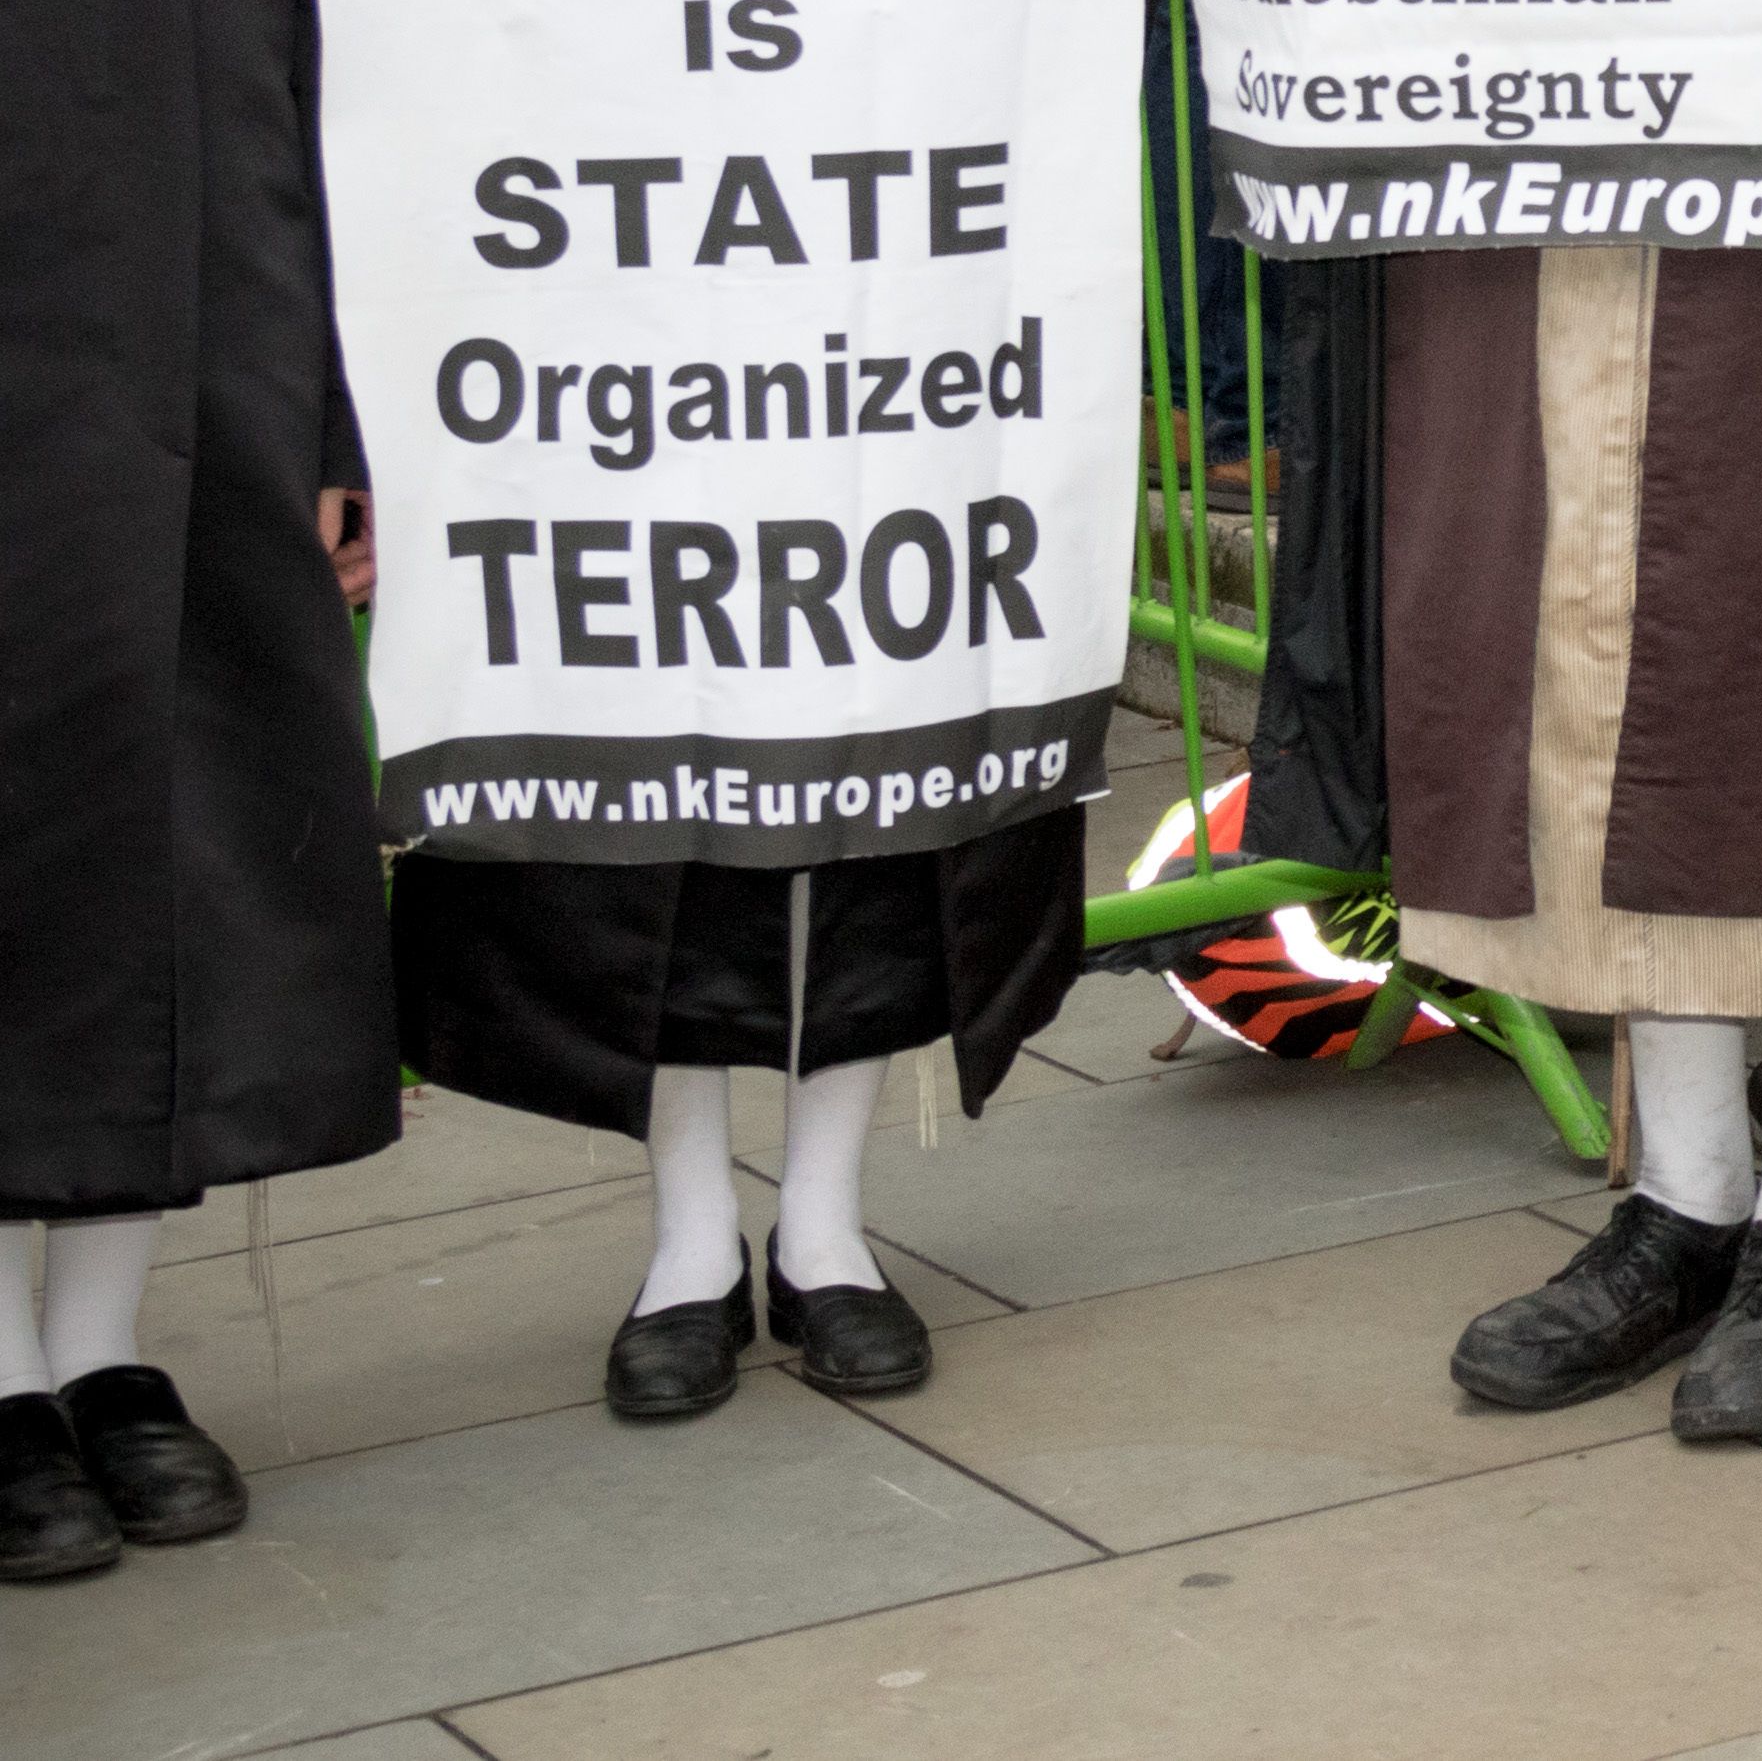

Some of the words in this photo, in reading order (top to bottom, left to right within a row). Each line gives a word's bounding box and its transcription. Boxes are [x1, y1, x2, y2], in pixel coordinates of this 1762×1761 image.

[1236, 50, 1693, 139] Sovereignty
[472, 141, 1010, 270] STATE
[435, 315, 1044, 471] Organized
[446, 494, 1047, 669] TERROR
[424, 736, 1069, 828] www.nkEurope.org
